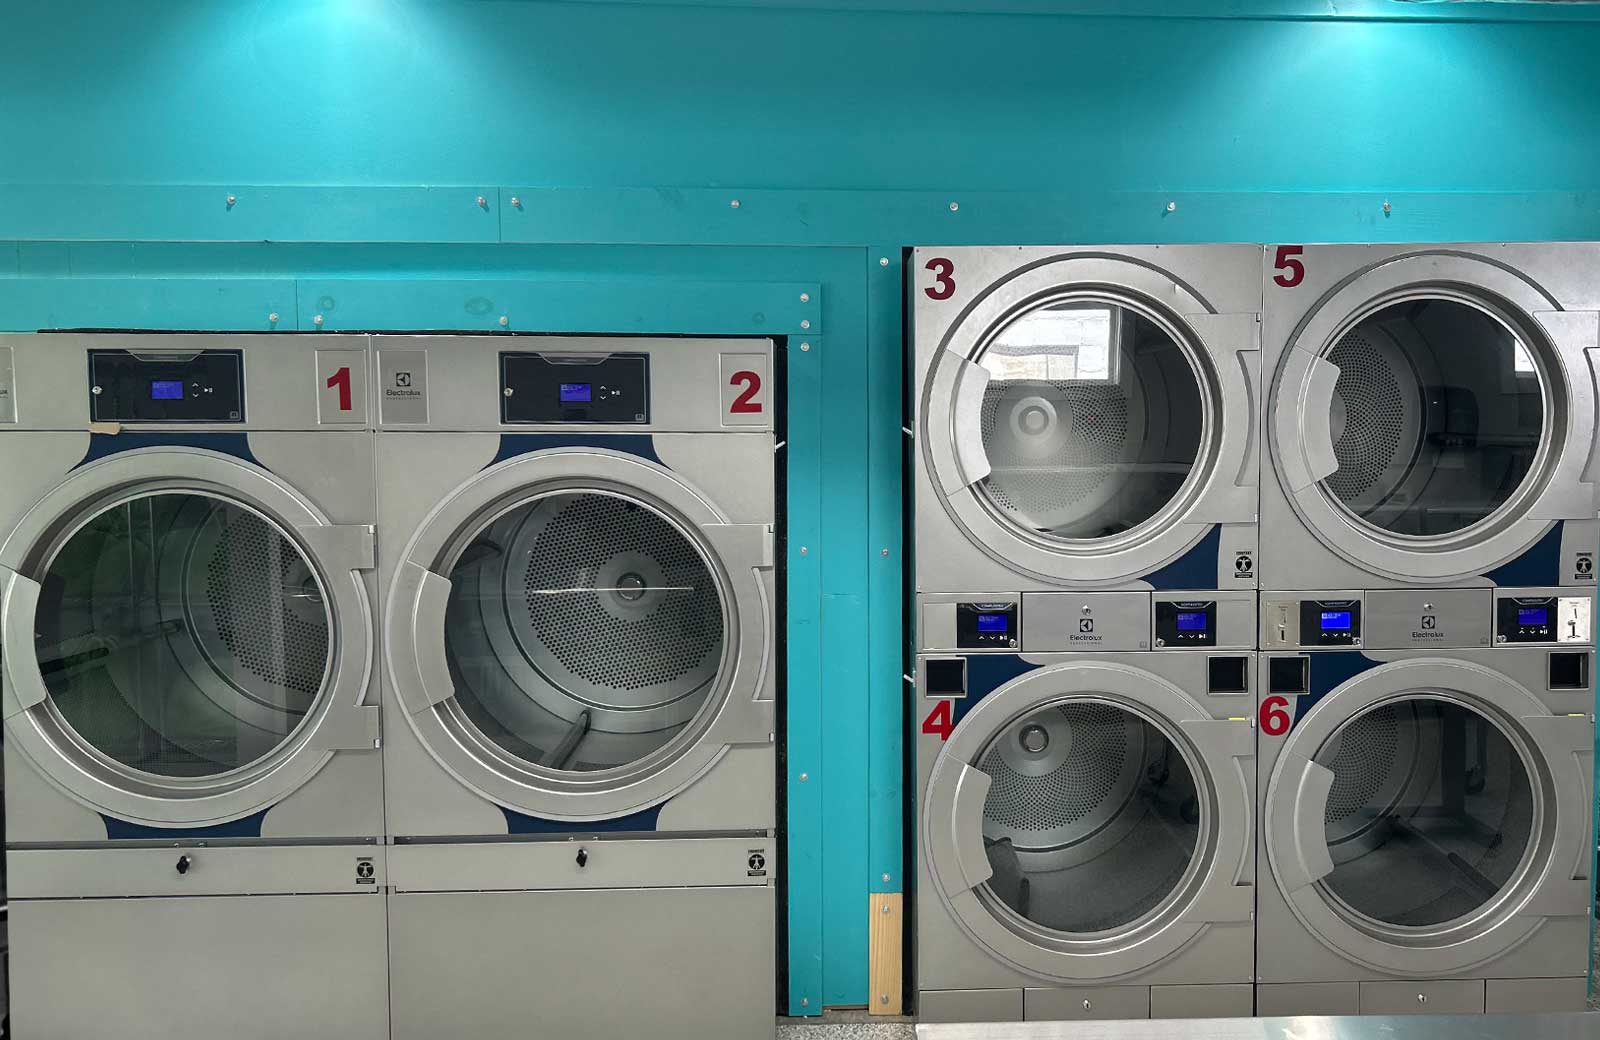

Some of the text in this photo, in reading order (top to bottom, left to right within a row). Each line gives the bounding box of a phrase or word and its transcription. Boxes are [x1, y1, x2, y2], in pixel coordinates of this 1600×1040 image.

[925, 258, 955, 300] 3
[1273, 245, 1304, 287] 5
[327, 367, 352, 411] 1
[730, 371, 763, 414] 2
[922, 700, 955, 742] 4
[1258, 695, 1290, 737] 6
